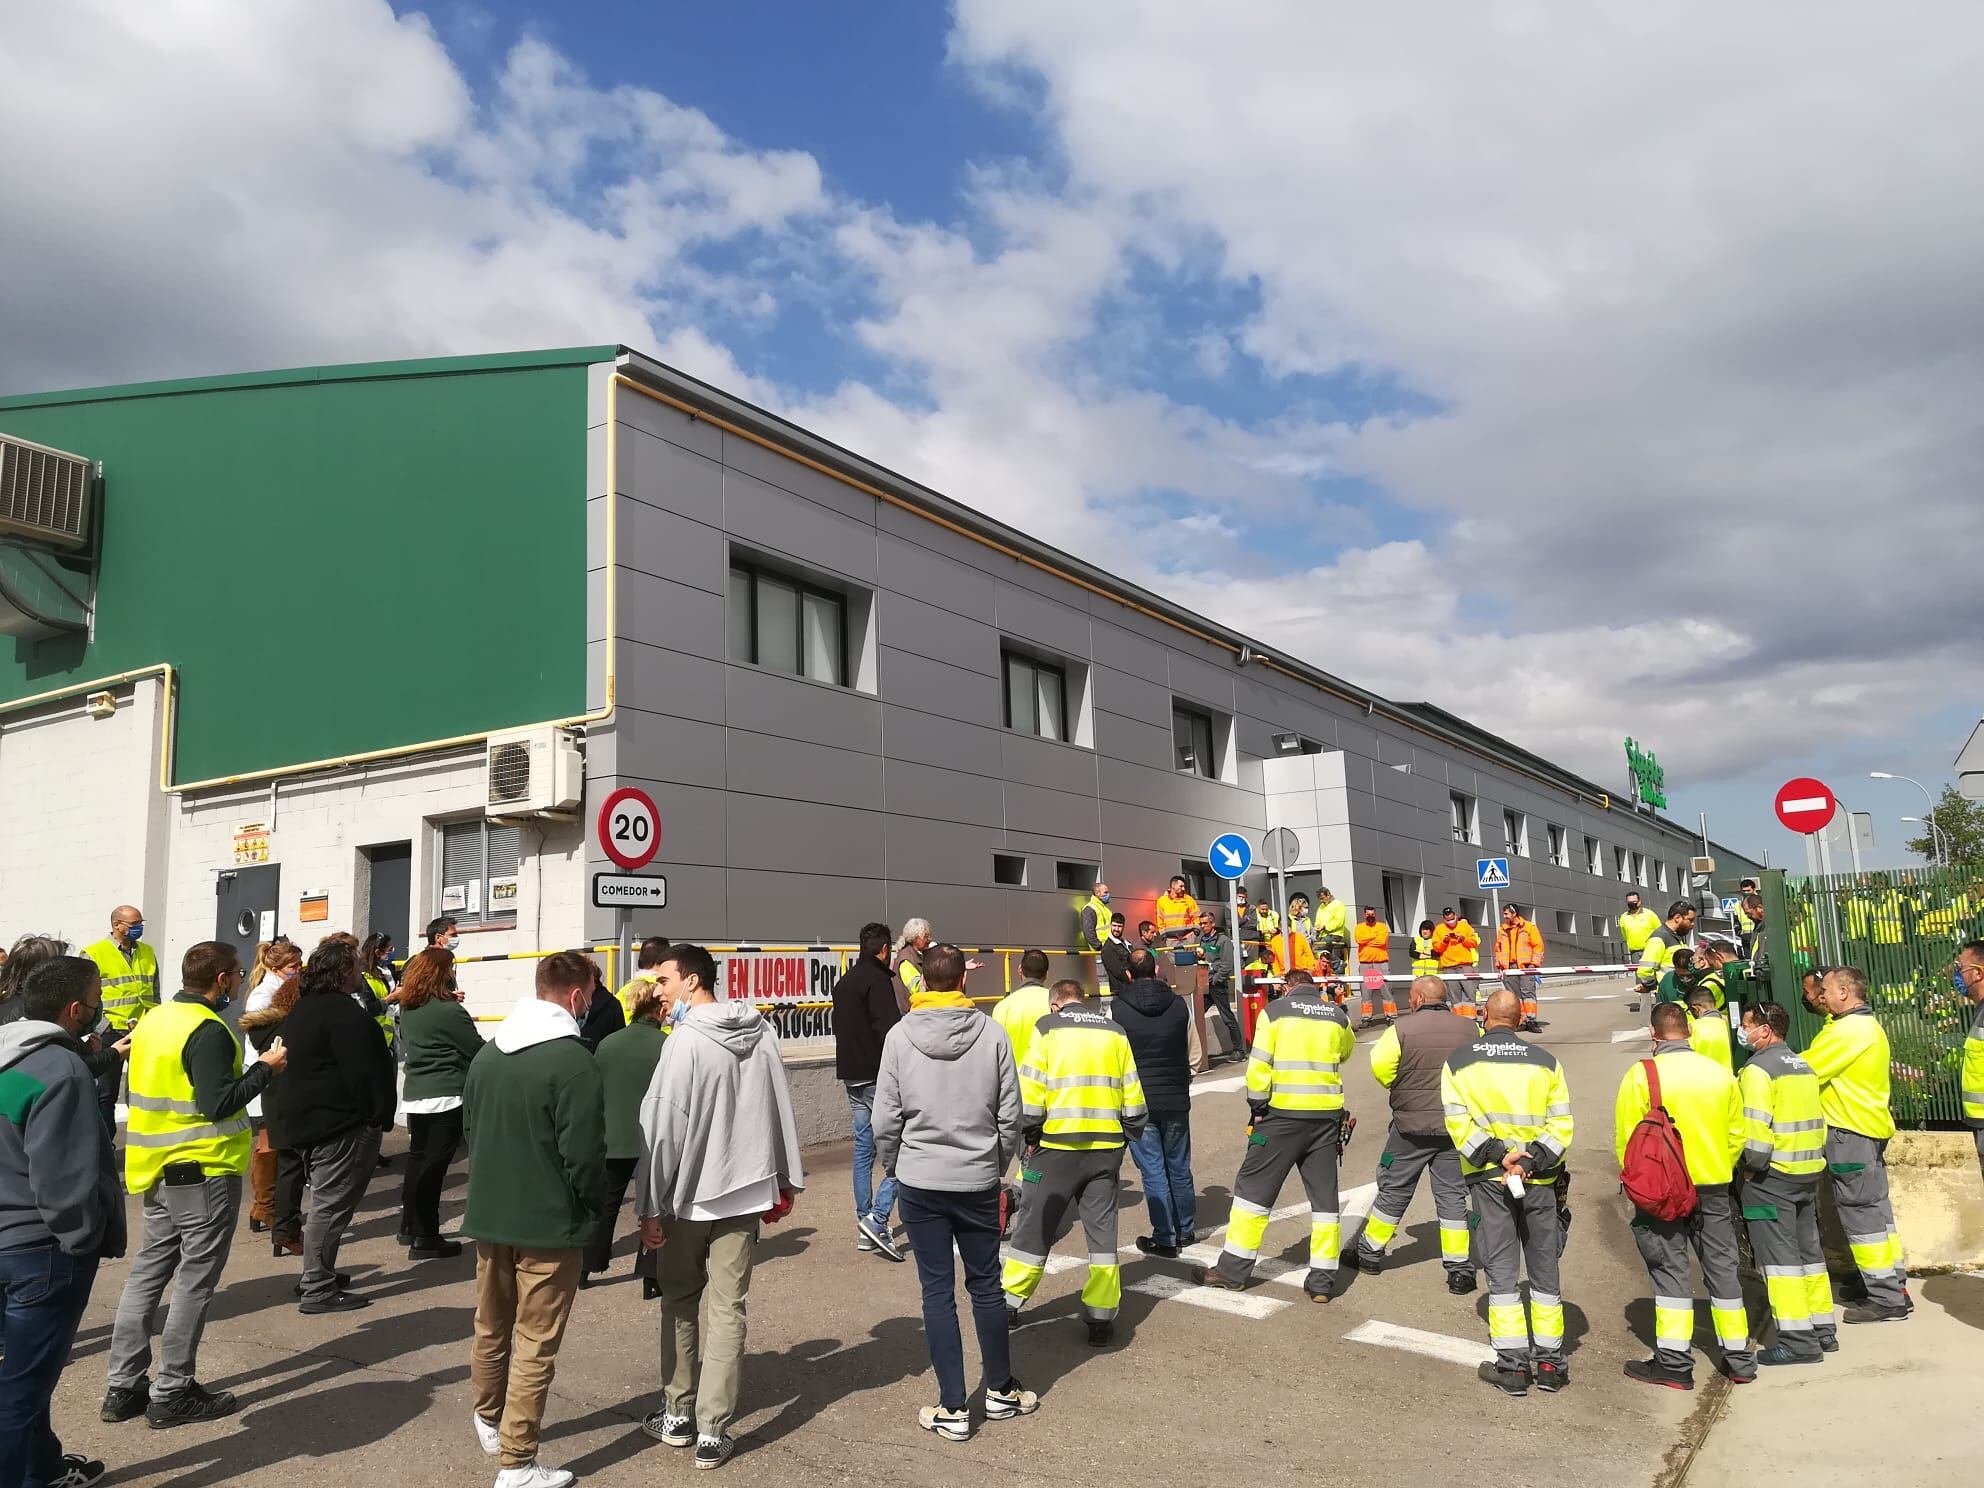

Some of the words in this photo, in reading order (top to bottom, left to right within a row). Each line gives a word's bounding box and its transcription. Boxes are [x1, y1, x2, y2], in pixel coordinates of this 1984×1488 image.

[615, 813, 649, 842] 20
[601, 885, 648, 896] COMEDOR
[728, 958, 749, 999] EN
[754, 957, 807, 998] LUCHA
[811, 958, 837, 996] Por
[1364, 975, 1384, 983] STOP
[1290, 1001, 1335, 1013] Schneider
[1472, 1042, 1529, 1054] Schneider
[1496, 1049, 1529, 1057] Electric
